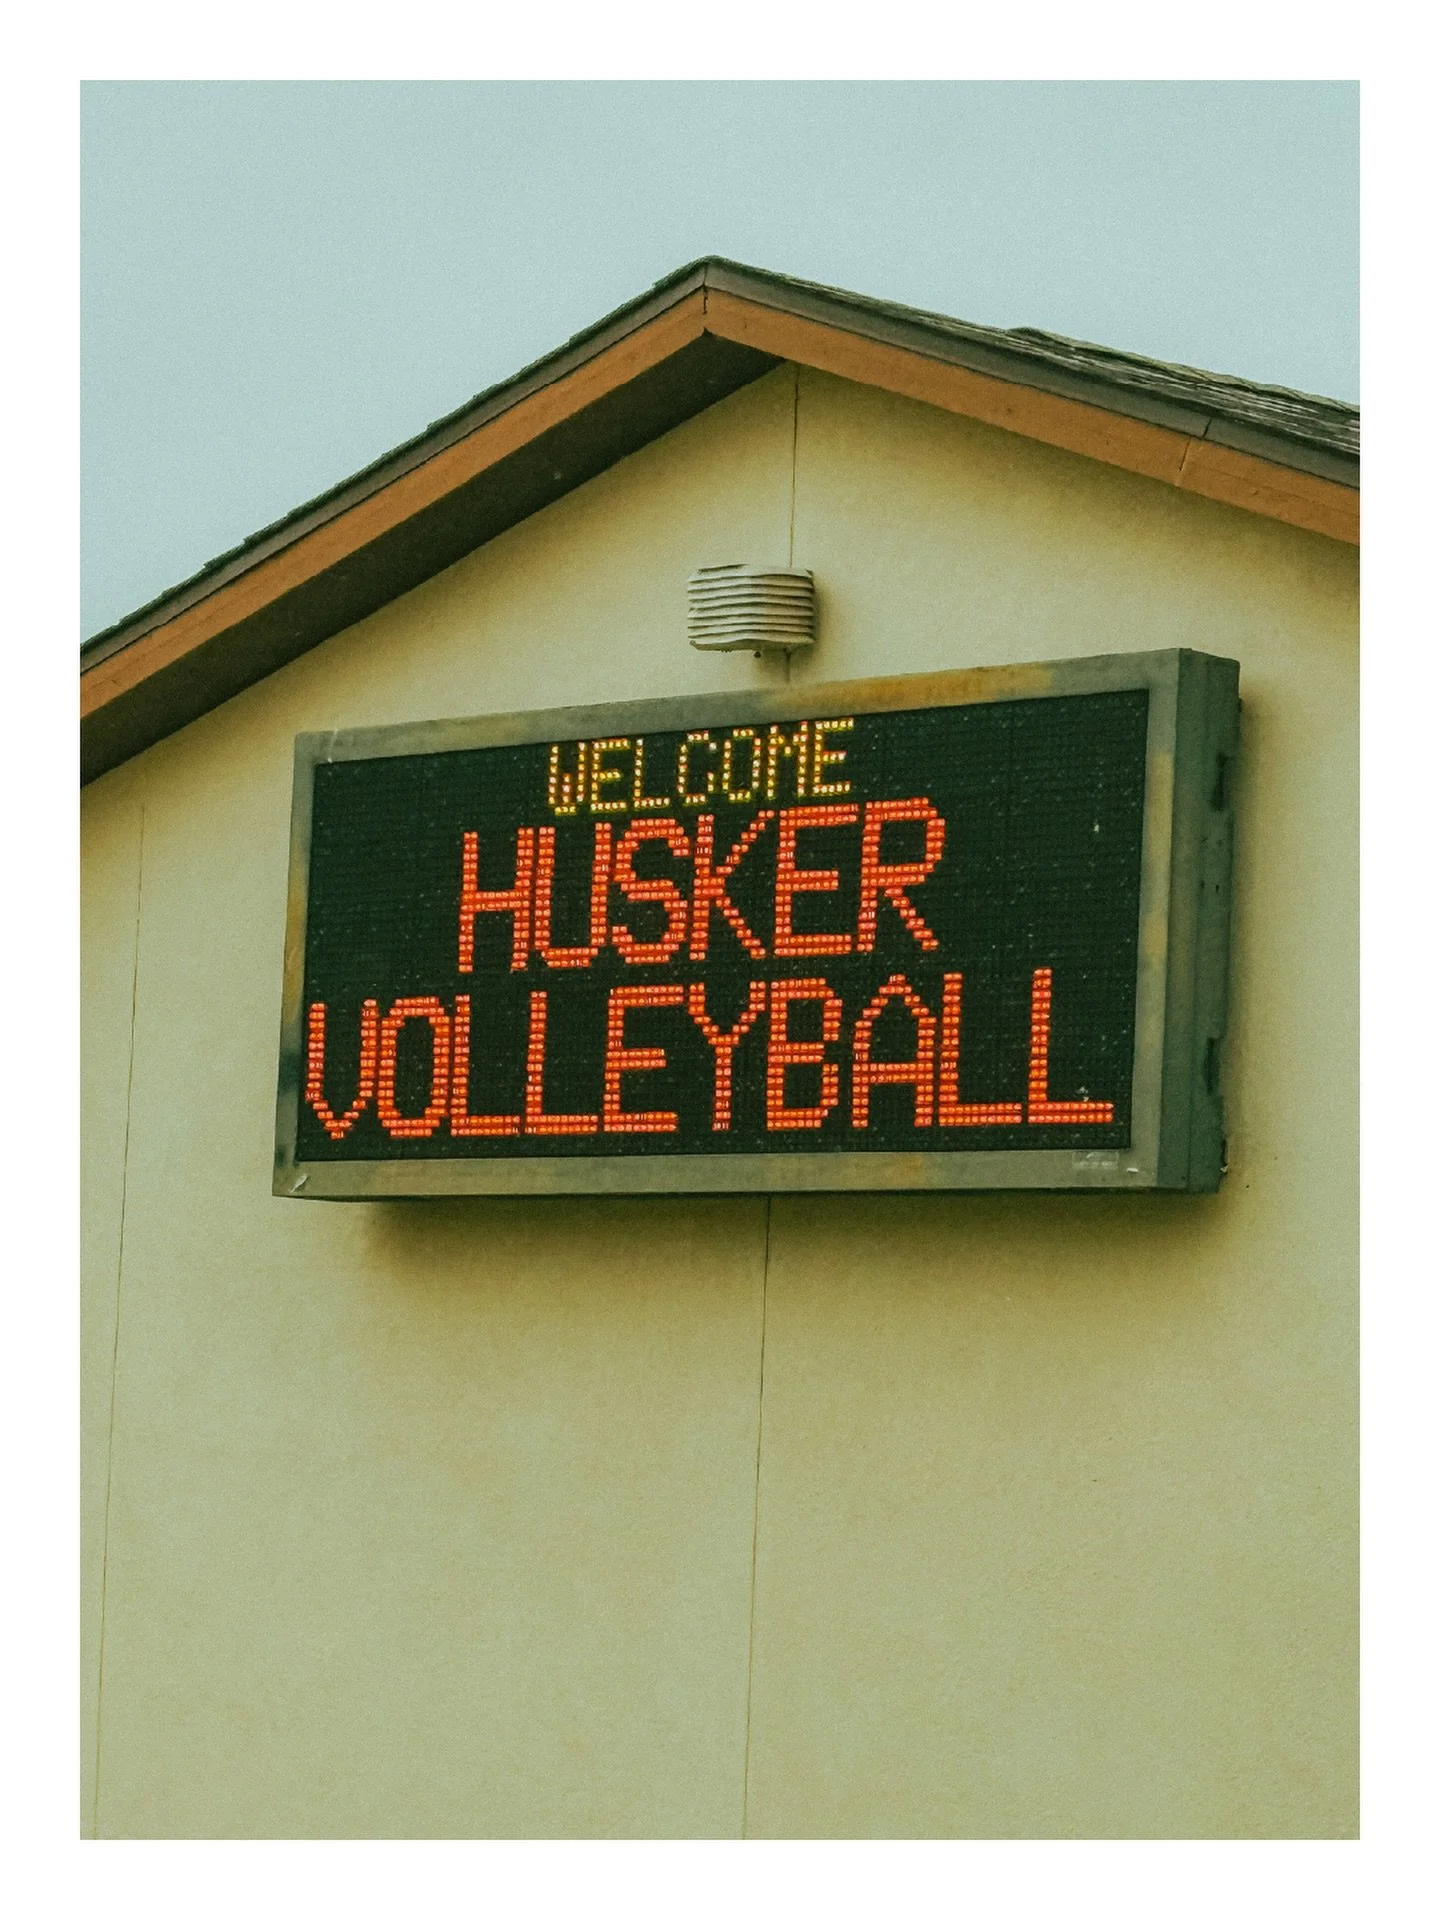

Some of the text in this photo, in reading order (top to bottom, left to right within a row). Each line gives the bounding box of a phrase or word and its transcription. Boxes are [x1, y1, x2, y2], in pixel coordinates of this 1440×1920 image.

[547, 718, 855, 815] WELCOME
[458, 797, 946, 974] HUSKER
[305, 967, 1114, 1140] VOLLEYBALL
